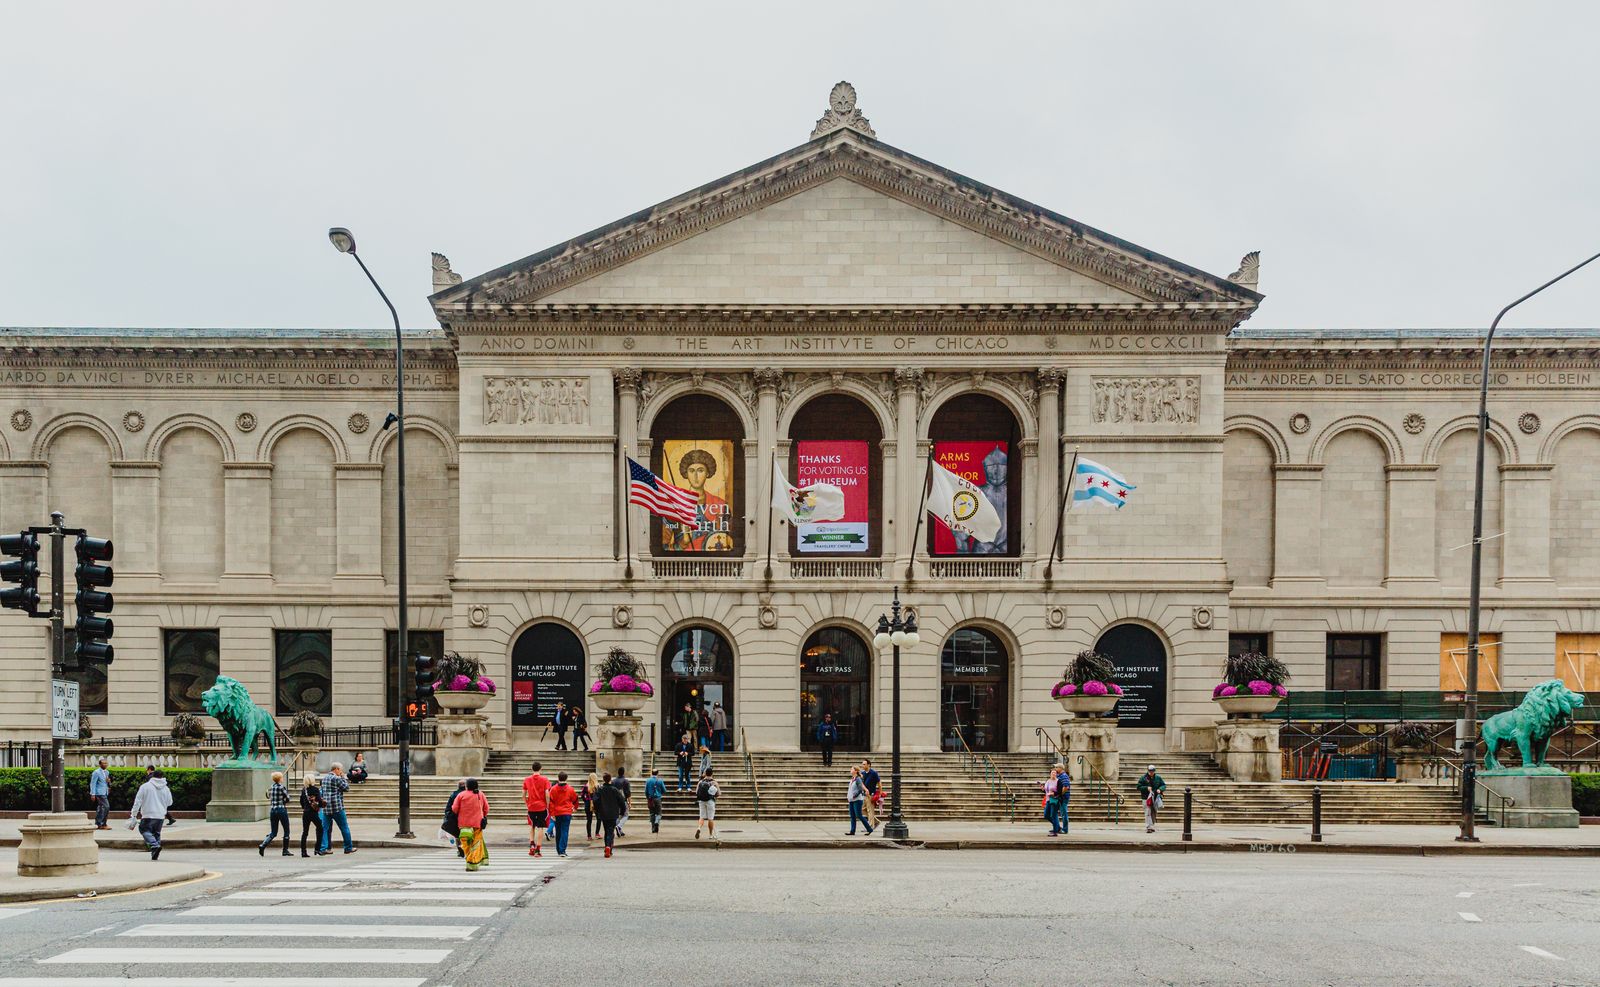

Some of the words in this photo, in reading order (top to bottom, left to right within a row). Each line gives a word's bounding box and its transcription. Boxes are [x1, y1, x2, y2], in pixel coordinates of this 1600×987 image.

[480, 337, 526, 350] ANNO
[533, 337, 595, 350] DOMINI
[676, 337, 708, 350] THE
[731, 337, 764, 350] ART
[784, 337, 873, 350] INSTITVTE
[893, 337, 916, 350] OF
[935, 337, 1009, 350] CHICAGO
[1089, 336, 1204, 349] MDCCCXCII
[0, 371, 47, 383] ARDO
[56, 372, 76, 383] DA
[83, 372, 123, 383] VINCI
[144, 372, 195, 384] DVRER
[216, 373, 287, 385] MICHAEL
[294, 373, 360, 385] ANGELO
[1260, 373, 1318, 385] ANDREA
[1324, 373, 1353, 385] DEL
[1358, 373, 1405, 385] SARTO
[1525, 373, 1591, 385] HOLBEIN
[799, 455, 841, 464] THANKS
[939, 452, 970, 462] ARMS
[799, 466, 817, 475] FOR
[819, 466, 854, 475] VOTING
[855, 466, 867, 475] US
[799, 477, 811, 486] #1
[814, 477, 858, 486] MUSEUM
[665, 521, 679, 529] and
[54, 685, 65, 697] TURN
[67, 687, 77, 698] LEFT
[62, 699, 69, 707] ON
[57, 720, 74, 733] ONLY
